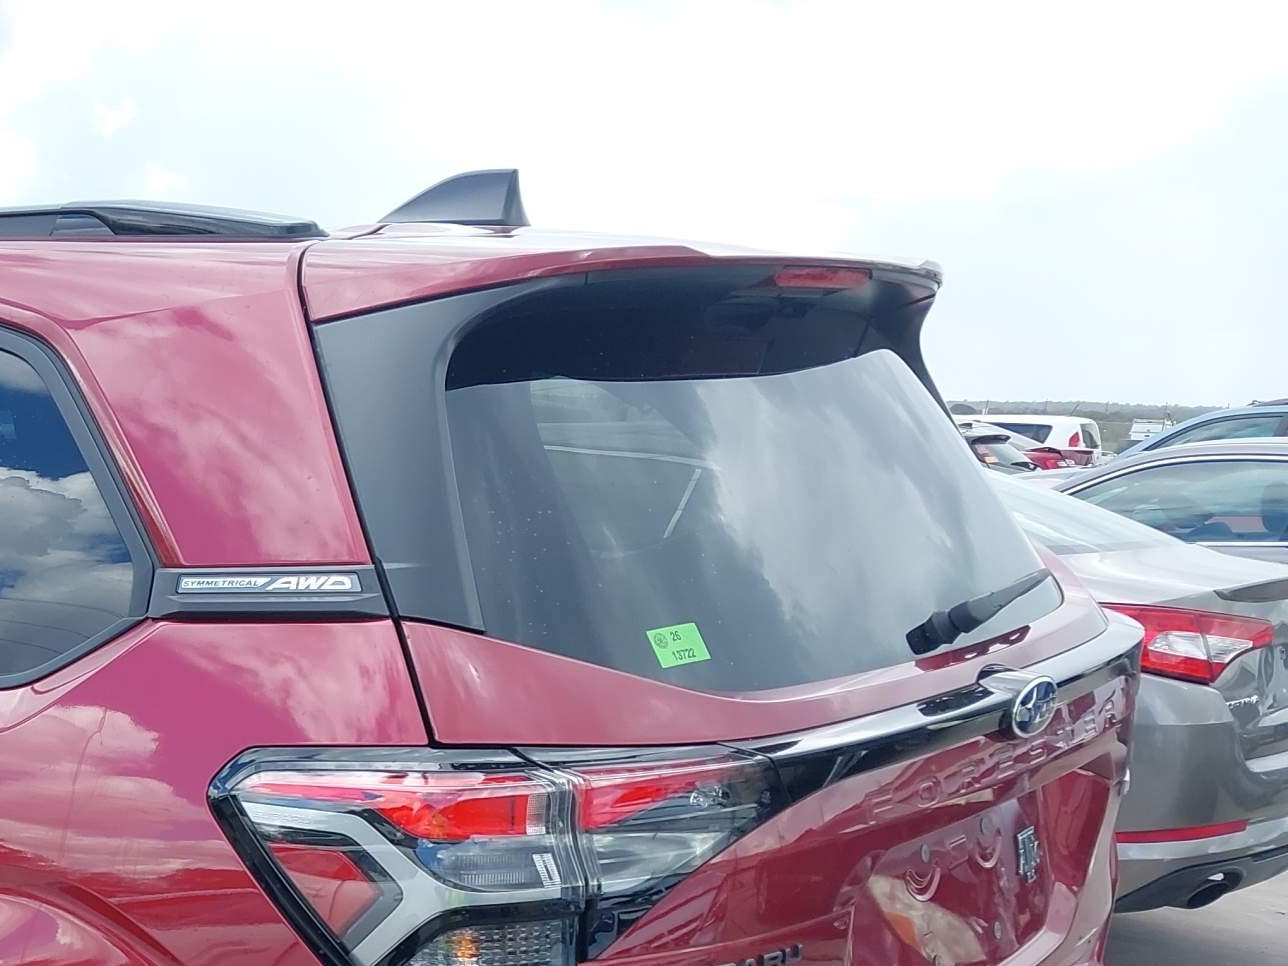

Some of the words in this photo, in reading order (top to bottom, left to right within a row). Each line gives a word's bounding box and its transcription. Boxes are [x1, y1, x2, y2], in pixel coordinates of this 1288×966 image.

[183, 579, 259, 588] SYMMETRICAL
[265, 576, 353, 591] AWD
[670, 630, 682, 641] 26
